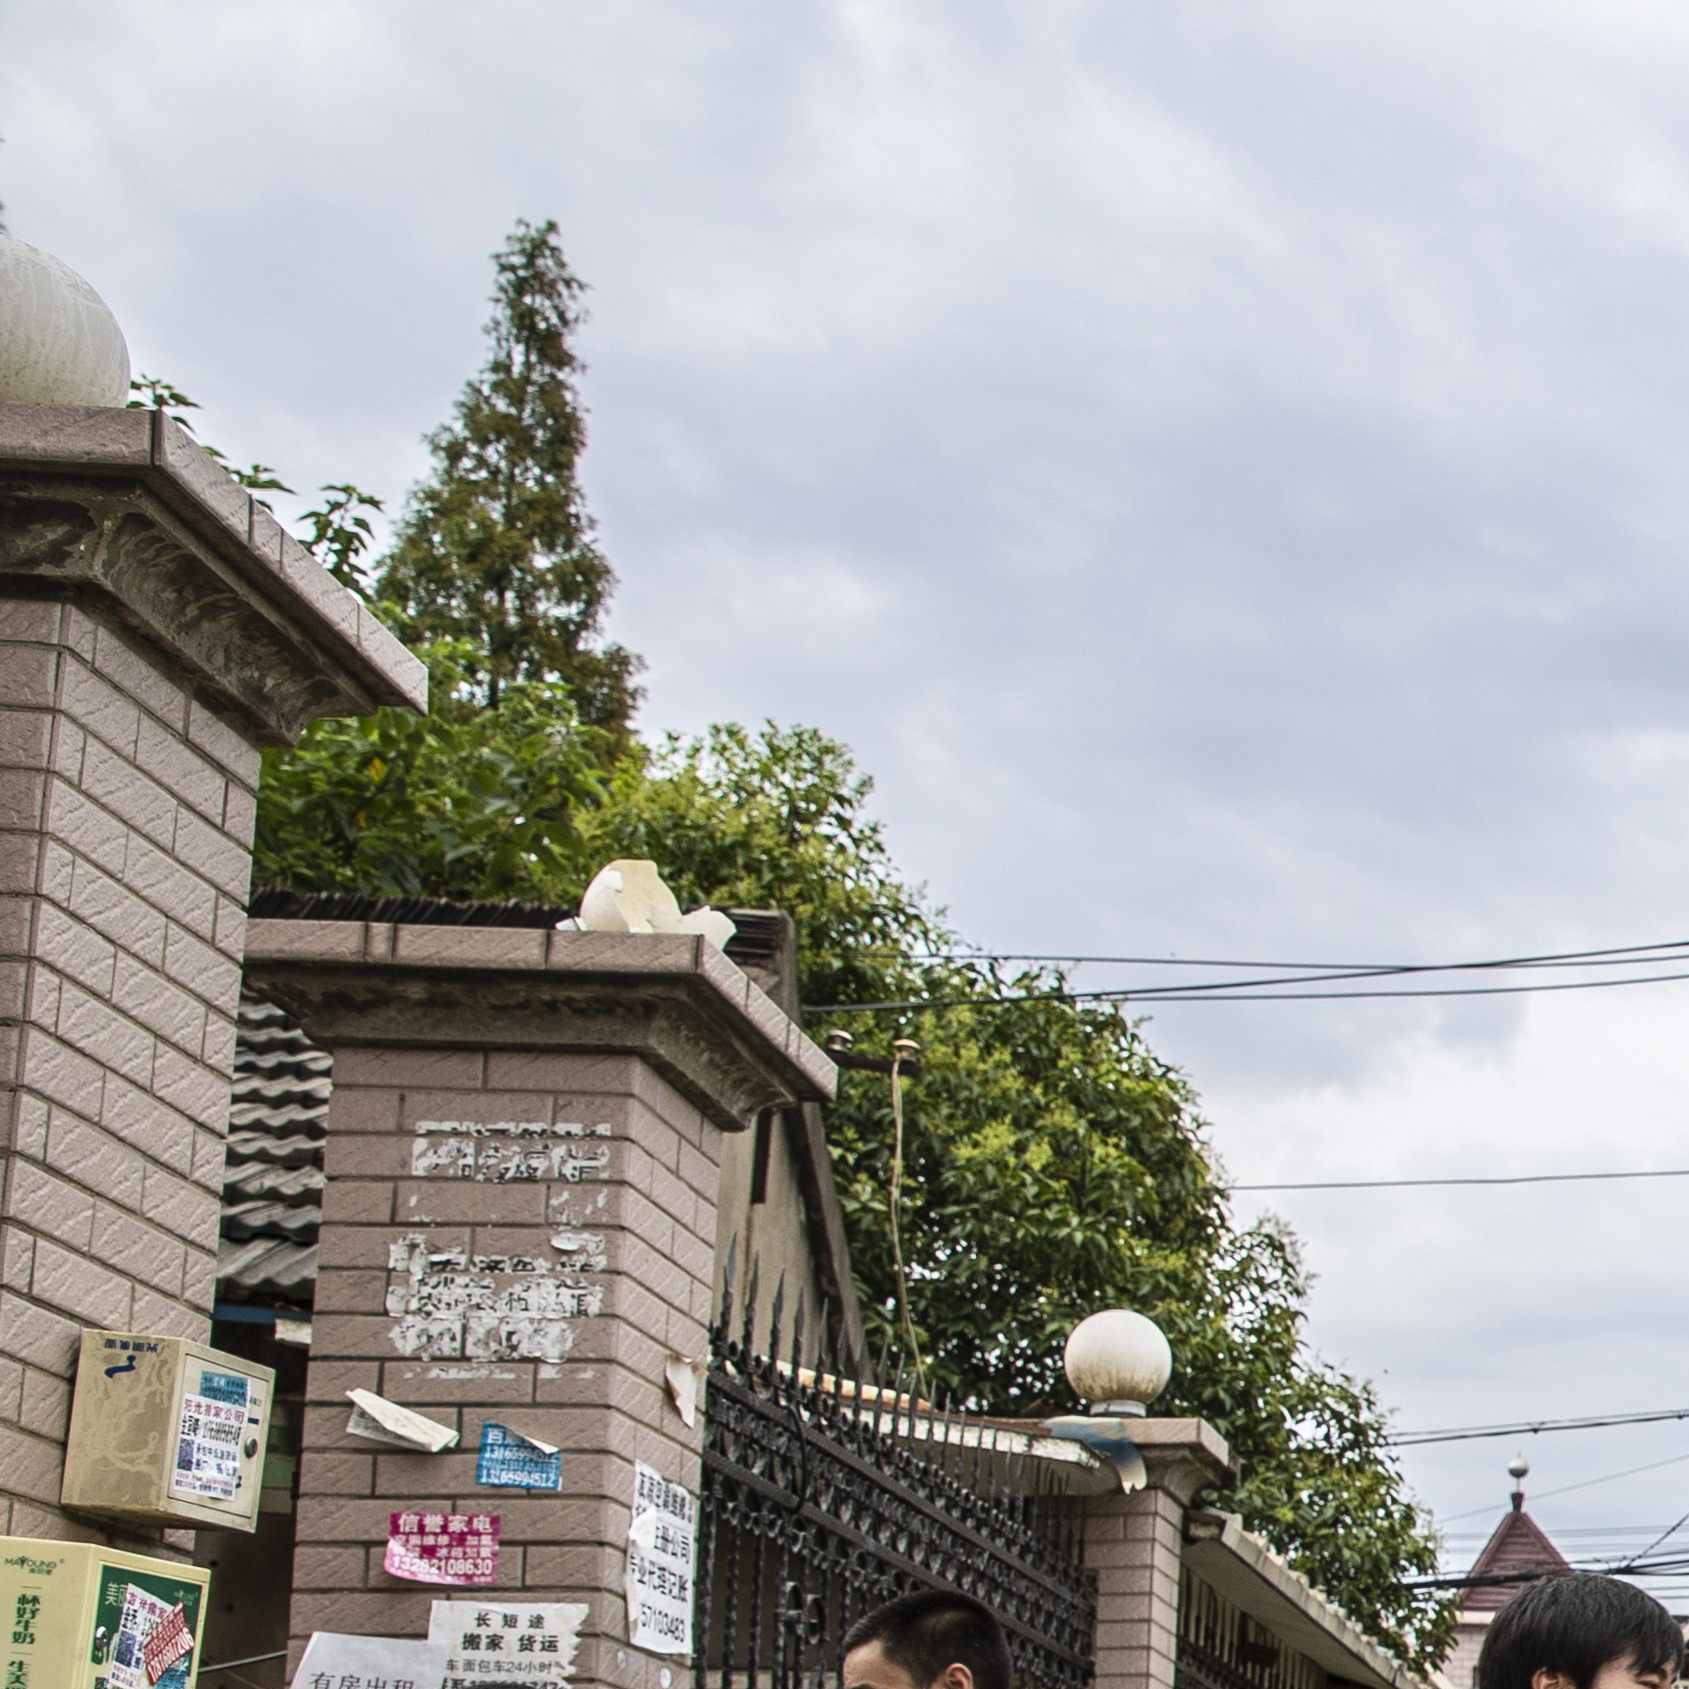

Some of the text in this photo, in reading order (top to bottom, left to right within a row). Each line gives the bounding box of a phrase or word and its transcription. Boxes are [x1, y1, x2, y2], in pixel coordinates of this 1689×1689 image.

[398, 1514, 494, 1534] 信誉家电
[392, 1556, 493, 1575] 13282108630
[474, 1612, 546, 1629] 长短途
[461, 1632, 560, 1653] 搬家 货运
